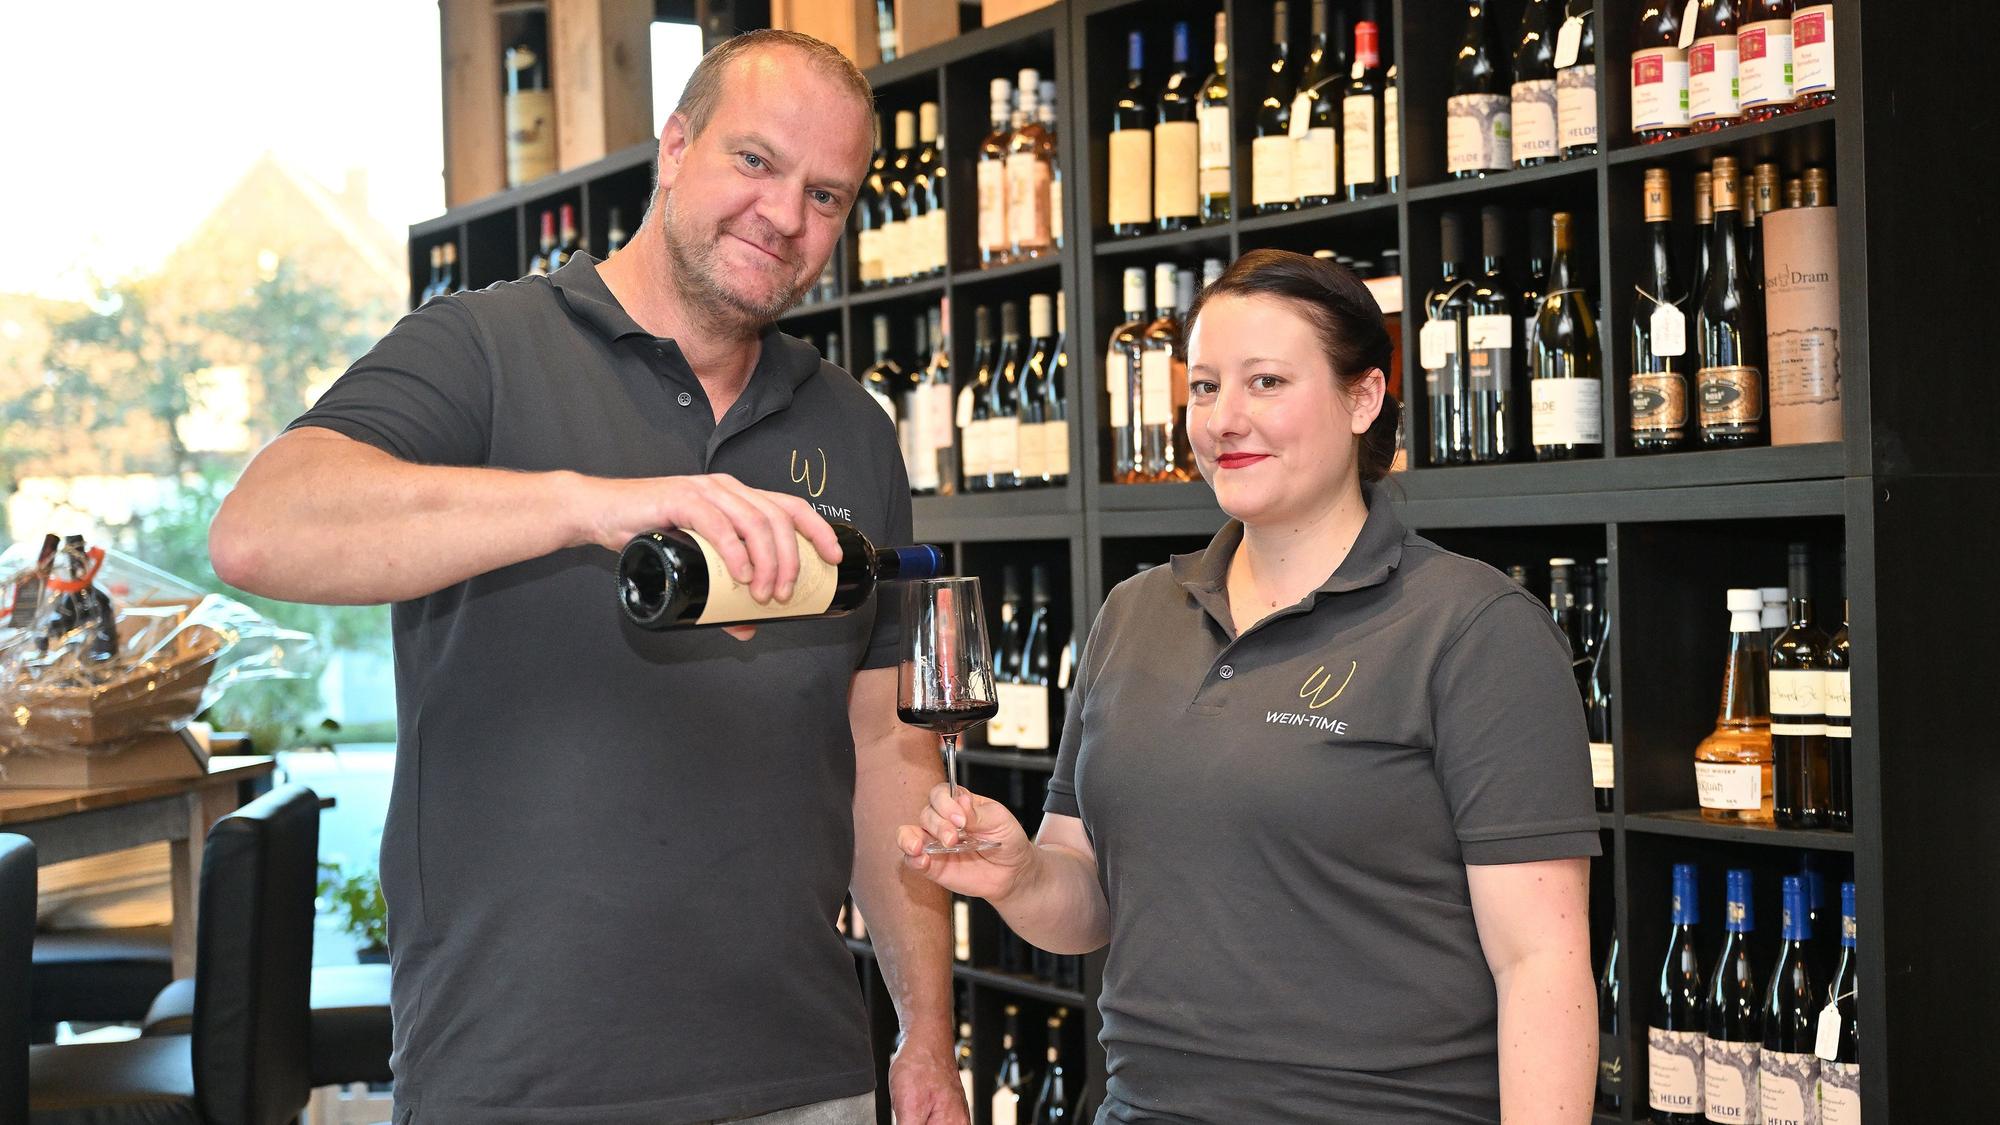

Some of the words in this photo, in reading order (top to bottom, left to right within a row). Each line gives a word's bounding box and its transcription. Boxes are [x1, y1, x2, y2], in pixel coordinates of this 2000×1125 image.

[1522, 140, 1551, 150] HELDE
[1791, 271, 1829, 285] Dram
[1265, 710, 1349, 736] WEIN-TIME
[1660, 1092, 1693, 1105] HELDE
[1711, 1104, 1741, 1117] HELDE
